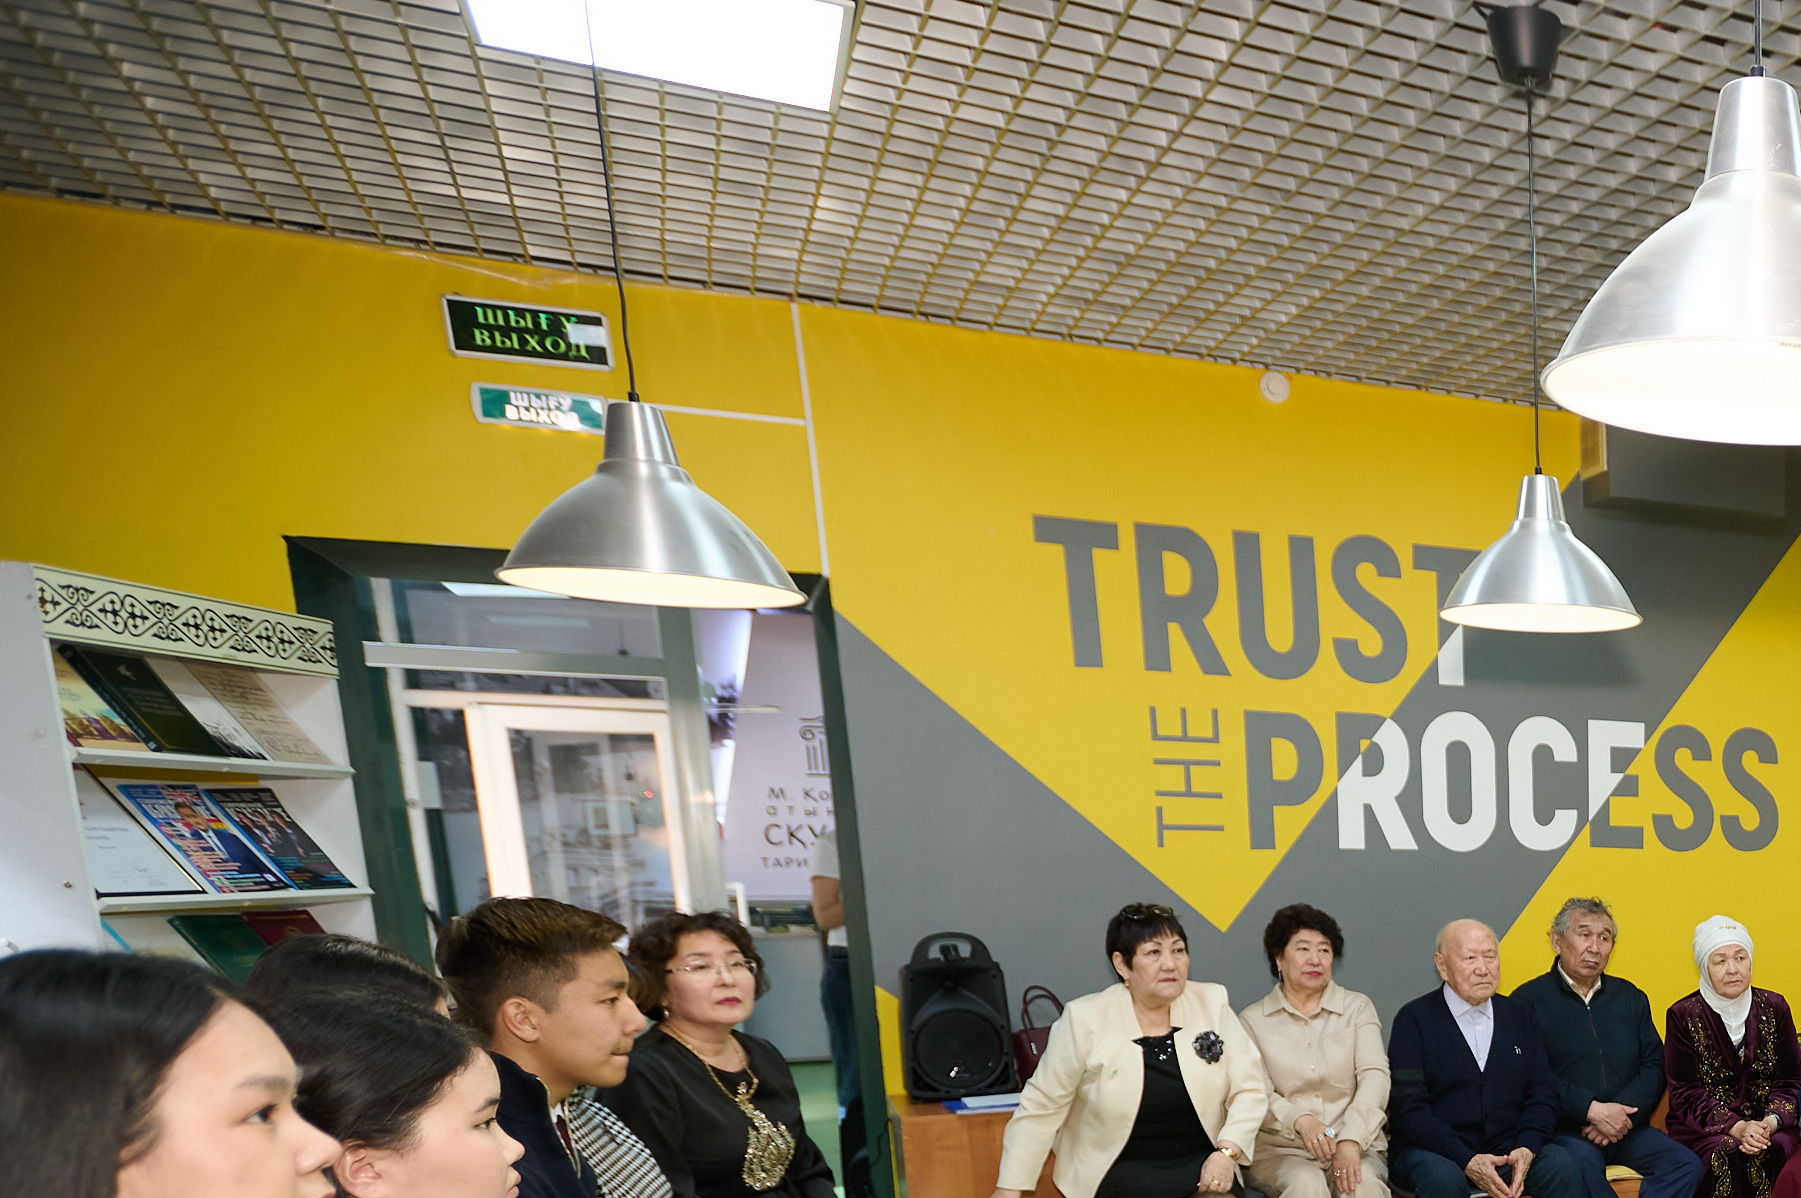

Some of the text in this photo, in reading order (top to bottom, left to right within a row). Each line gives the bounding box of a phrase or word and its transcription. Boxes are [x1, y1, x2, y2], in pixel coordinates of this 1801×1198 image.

[472, 327, 591, 360] ВЫХОД
[1031, 513, 1484, 687] TRUST
[1148, 704, 1780, 853] THE PROCESS
